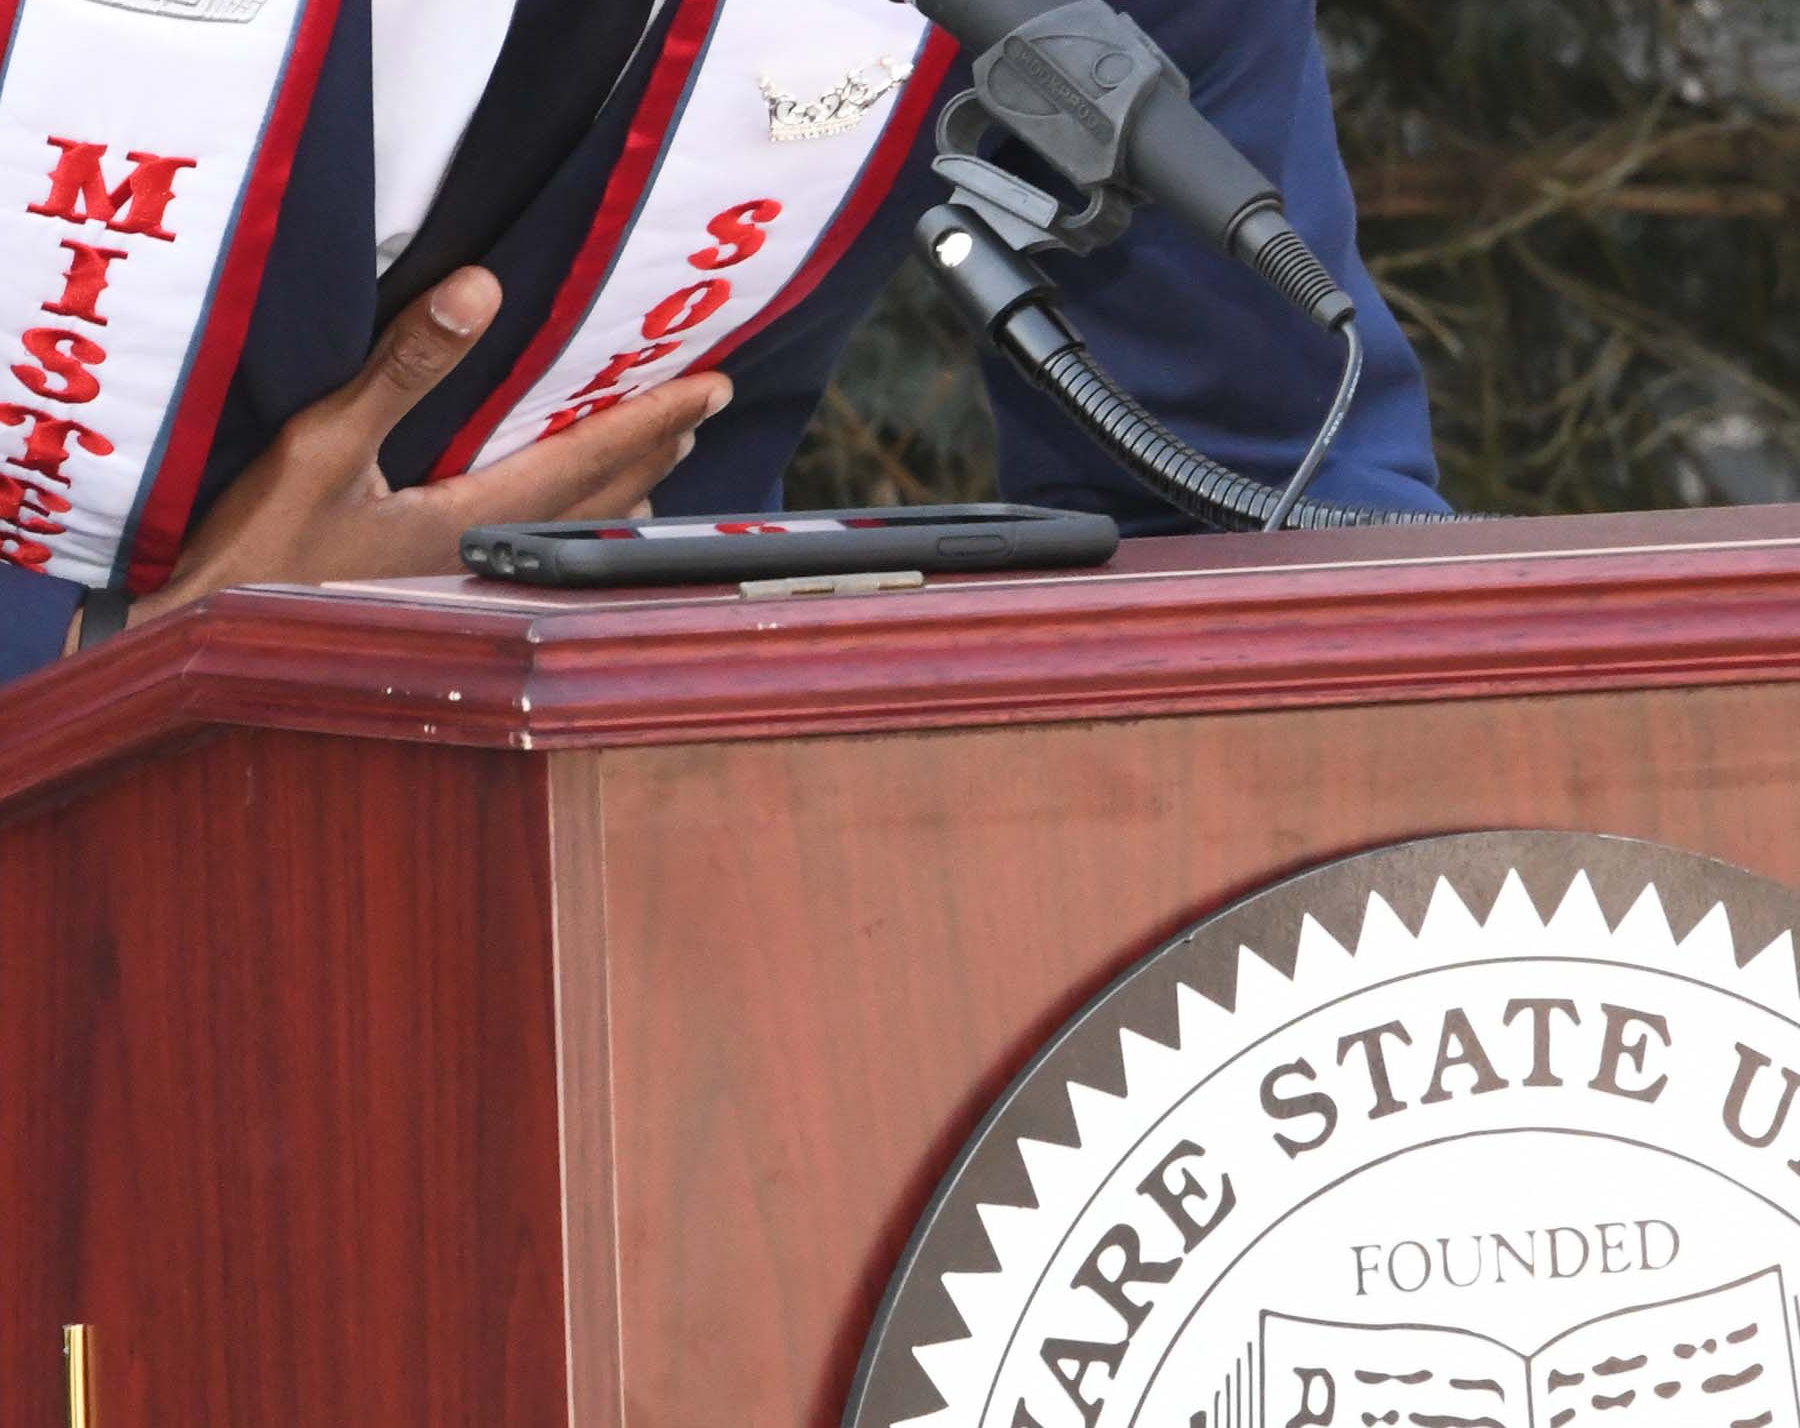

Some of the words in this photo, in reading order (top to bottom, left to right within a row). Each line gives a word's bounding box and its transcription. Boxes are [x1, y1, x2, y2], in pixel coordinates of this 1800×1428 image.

[1011, 1140, 1236, 1428] ARE
[1259, 998, 1672, 1159] STATE
[1721, 1041, 1800, 1176] U
[1350, 1218, 1681, 1296] FOUNDED
